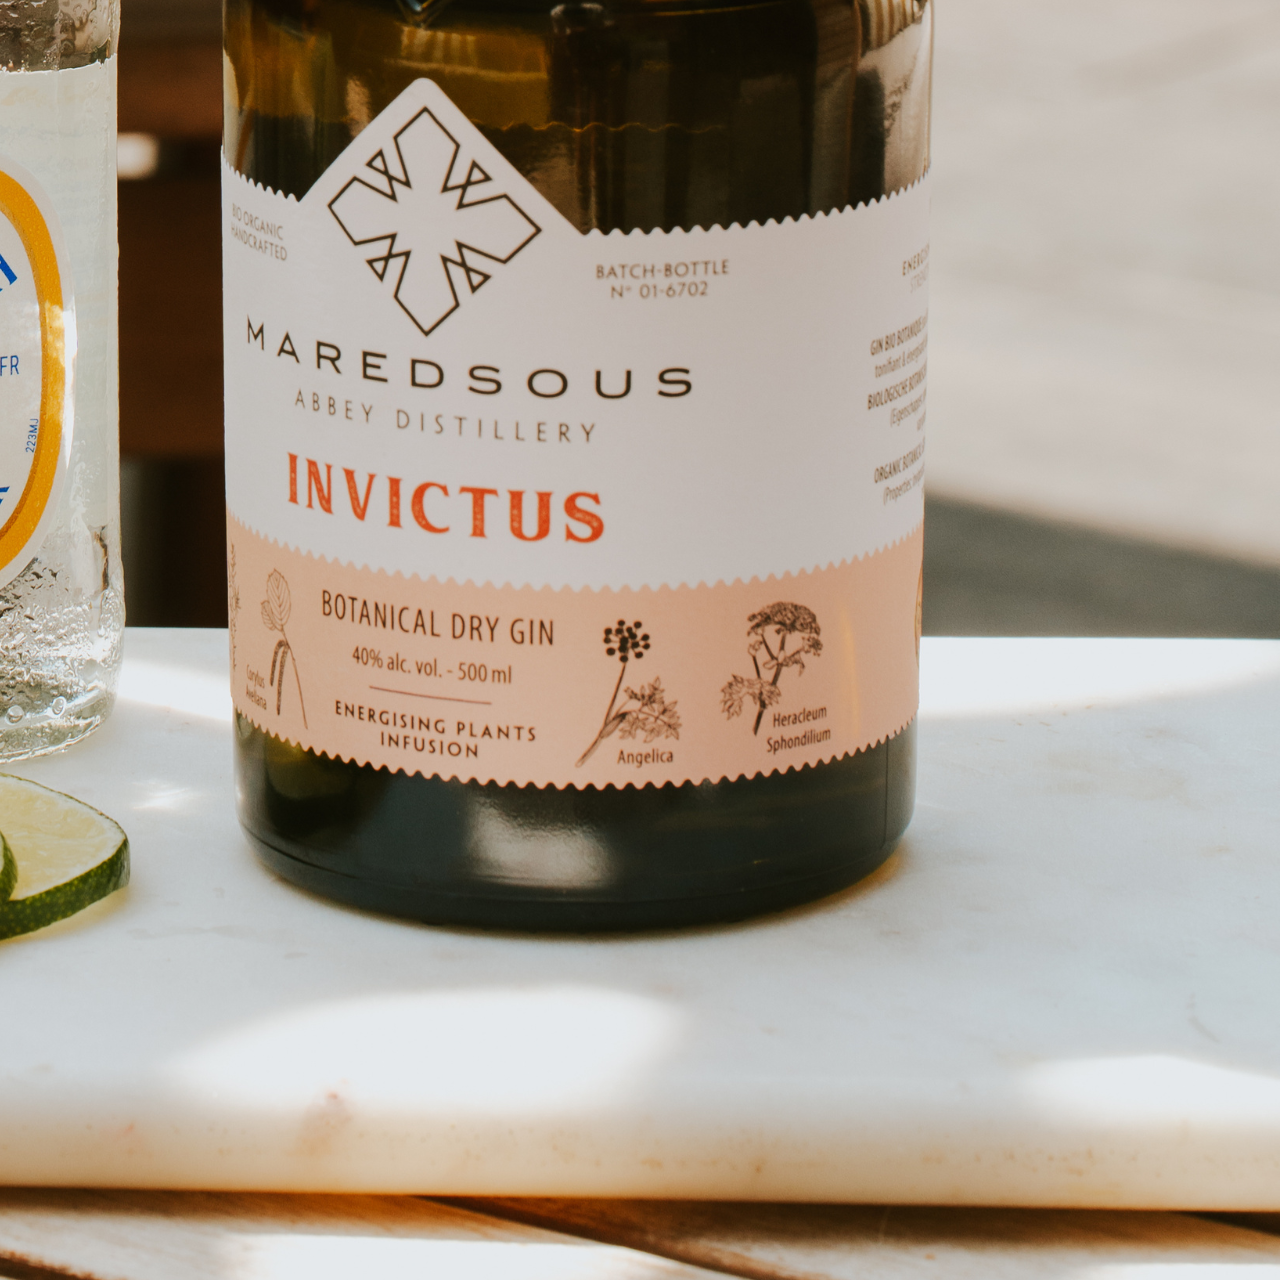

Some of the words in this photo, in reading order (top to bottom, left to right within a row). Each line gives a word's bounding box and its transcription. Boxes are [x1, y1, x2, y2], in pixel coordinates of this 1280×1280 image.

[230, 221, 288, 261] HANDCRAFTED
[243, 210, 284, 241] ORGANIC
[595, 258, 730, 280] BATCH-BOTTLE
[638, 279, 709, 300] 01-6702
[246, 314, 694, 400] MAREDSOUS
[295, 388, 373, 424] ABBEY
[396, 408, 596, 444] DISTILLERY
[25, 418, 39, 453] 223MJ
[287, 451, 605, 544] INVICTUS
[322, 589, 441, 638] BOTANICAL
[451, 612, 500, 643] DRY
[509, 618, 555, 647] GIN
[352, 645, 383, 669] 40%
[387, 652, 412, 674] alc.
[415, 657, 443, 679] vol.
[458, 662, 488, 684] 500
[491, 665, 513, 685] ml
[335, 699, 446, 734] ENERGISING
[456, 720, 537, 742] PLANTS
[772, 706, 828, 729] Heracleum
[380, 730, 479, 759] INFUSION
[617, 749, 674, 769] Angelica
[766, 728, 832, 756] Sphondilium
